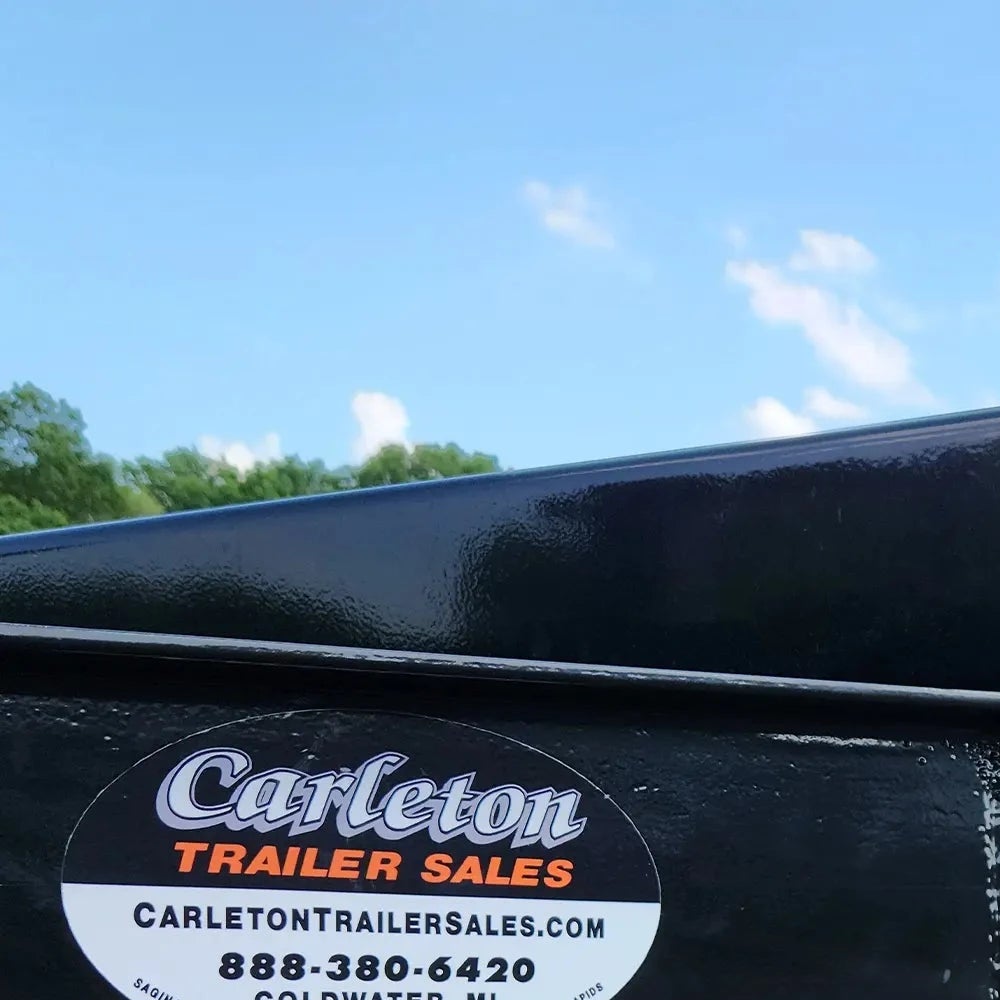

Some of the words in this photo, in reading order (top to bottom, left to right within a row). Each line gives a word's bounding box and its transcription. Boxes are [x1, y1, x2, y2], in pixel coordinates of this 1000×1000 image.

[156, 747, 588, 849] Carleton
[174, 842, 401, 881] TRAILER
[421, 853, 574, 888] SALES
[133, 902, 605, 939] CARLETONTRAILERSALES.COM
[218, 952, 536, 983] 888-380-6420
